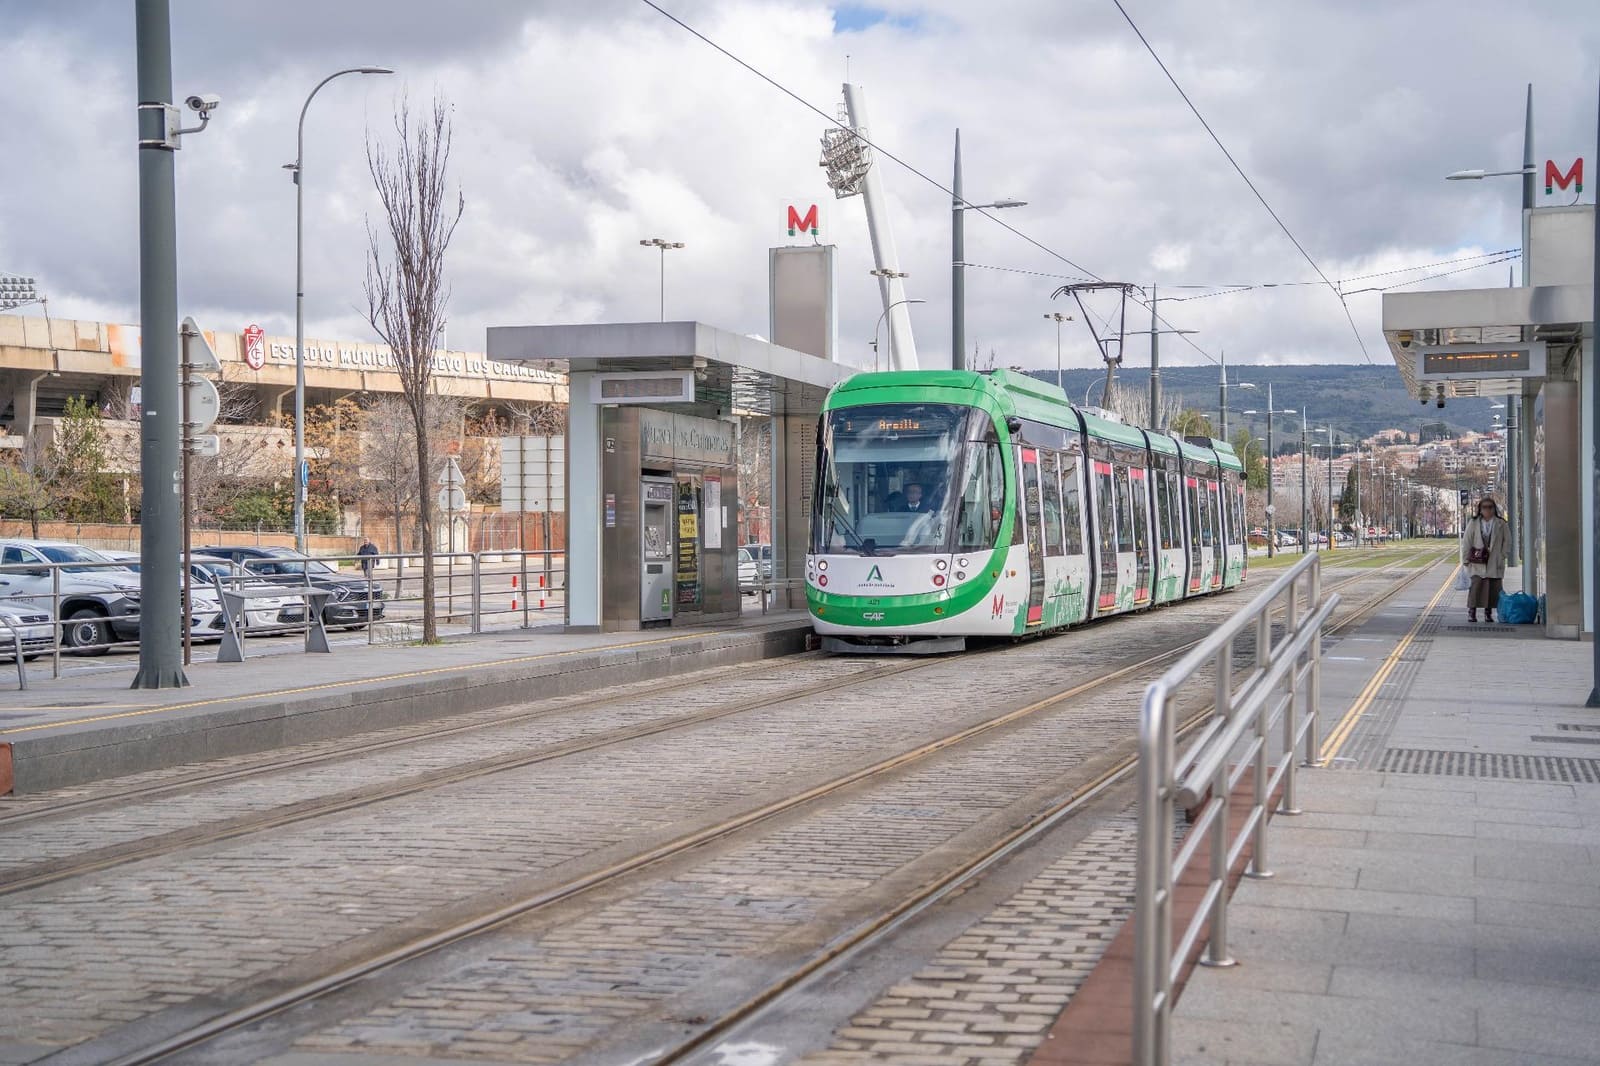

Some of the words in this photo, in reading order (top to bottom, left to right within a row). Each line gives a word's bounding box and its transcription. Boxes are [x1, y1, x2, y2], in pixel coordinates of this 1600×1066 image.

[1545, 157, 1584, 195] M
[787, 204, 818, 236] M
[270, 343, 333, 363] ESTDIO
[465, 359, 490, 374] LOS
